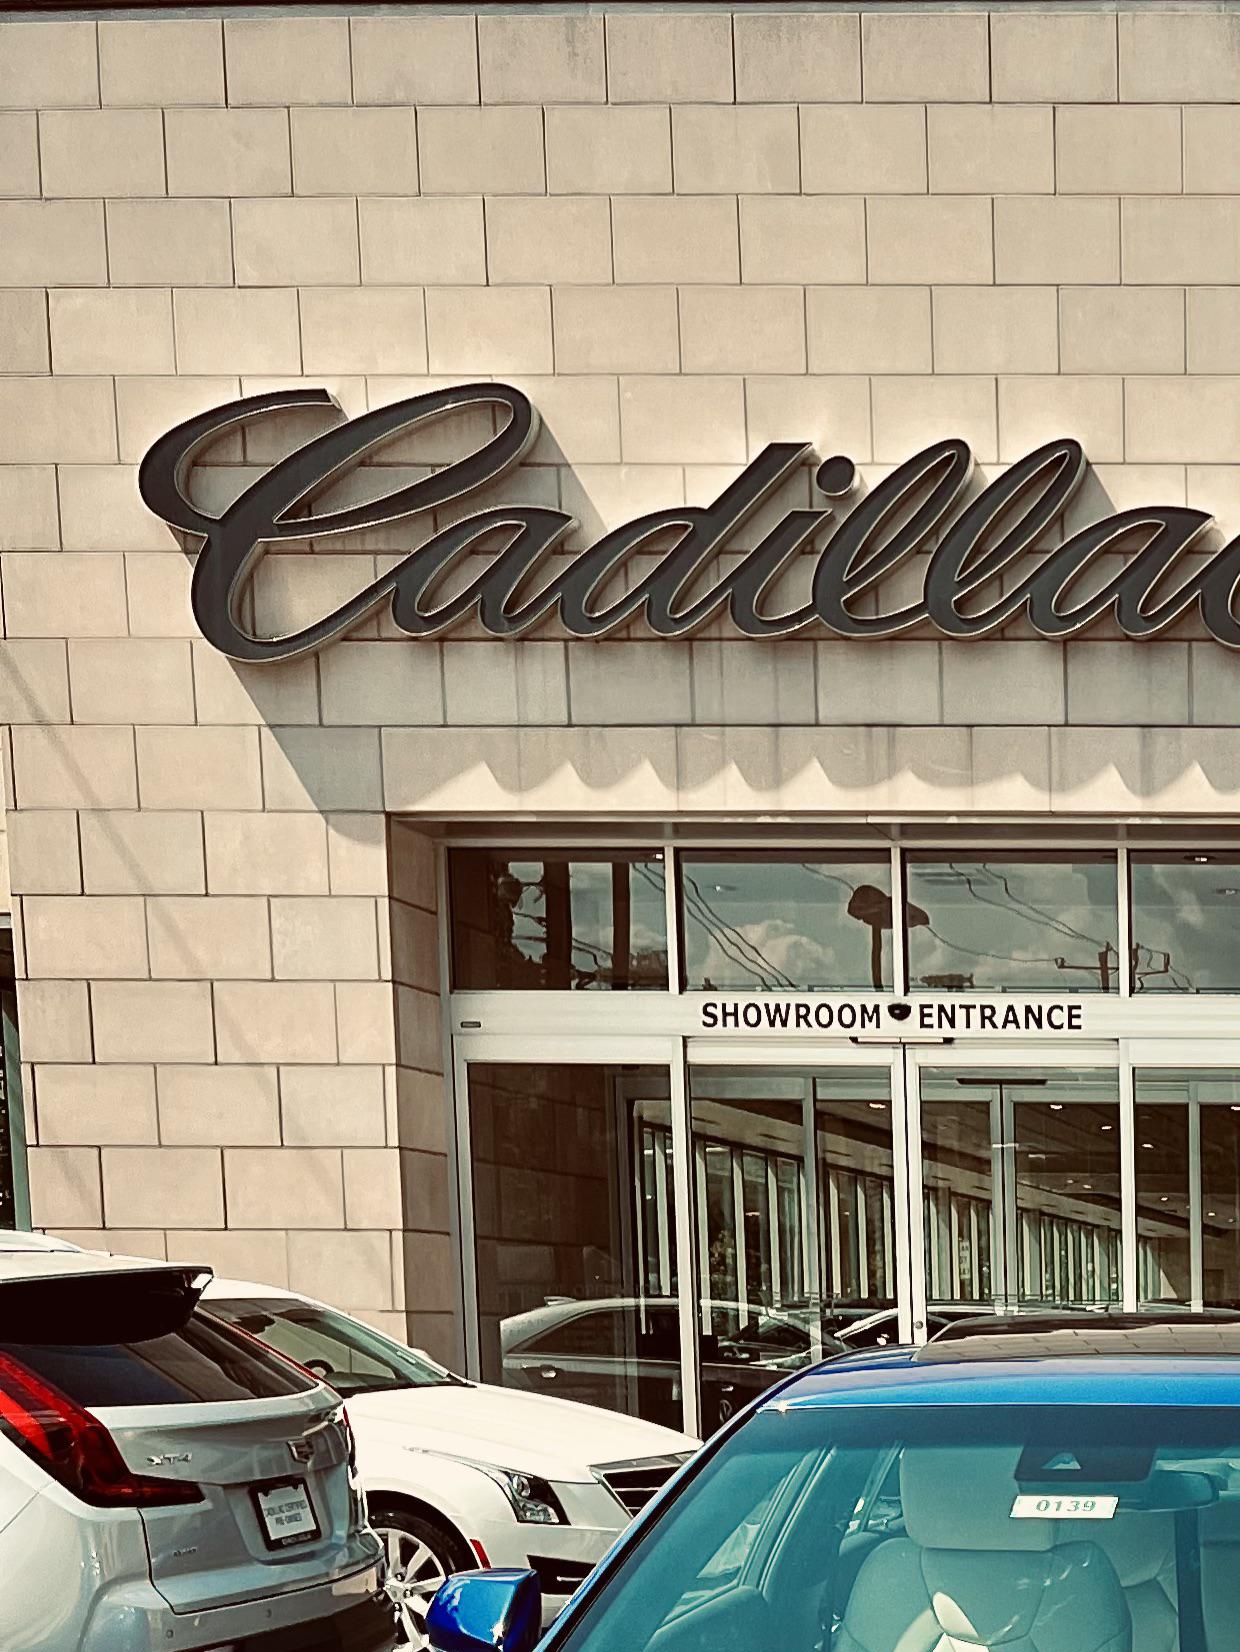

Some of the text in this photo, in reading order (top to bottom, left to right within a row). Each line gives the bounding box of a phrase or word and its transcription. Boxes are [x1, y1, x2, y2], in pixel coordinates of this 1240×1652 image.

[701, 1002, 1083, 1030] SHOWROOM ENTRANCE
[1035, 1499, 1097, 1512] 0139
